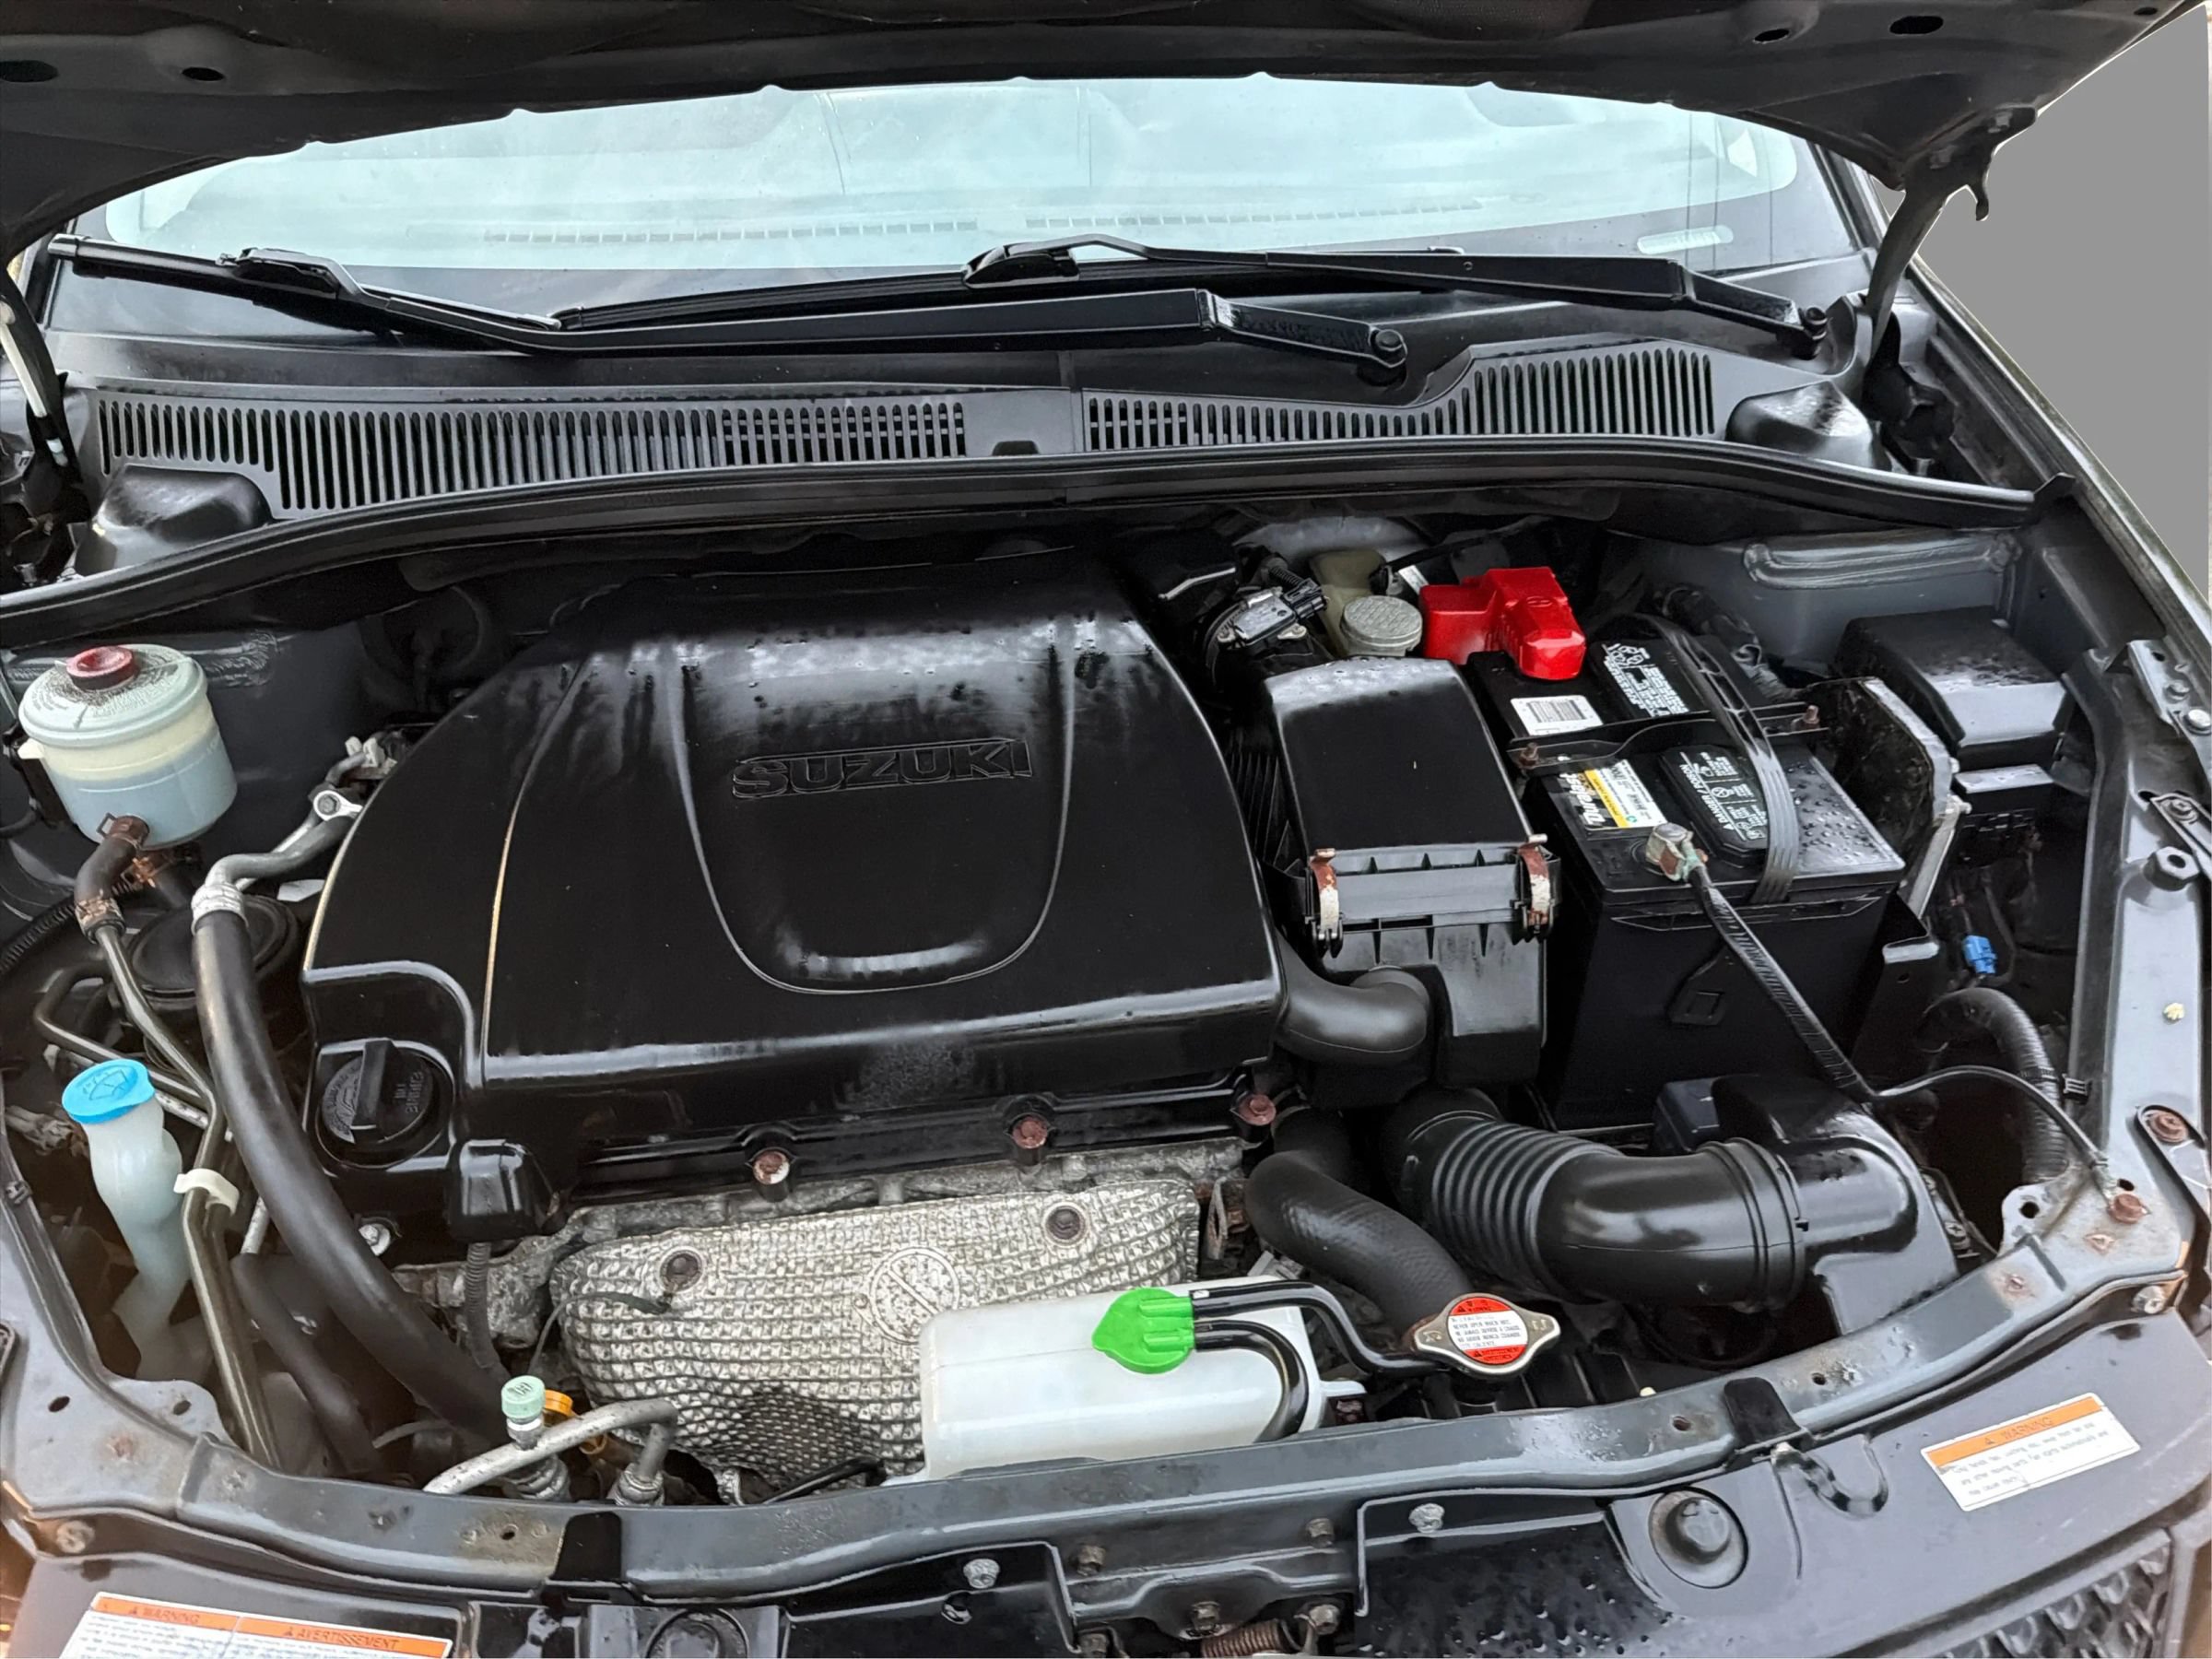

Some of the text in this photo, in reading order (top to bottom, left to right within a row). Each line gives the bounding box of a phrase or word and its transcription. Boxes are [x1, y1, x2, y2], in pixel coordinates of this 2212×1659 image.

[733, 737, 1032, 798] SUZUKI
[1679, 764, 1705, 789] POISON
[1558, 773, 1606, 826] Duralast
[1701, 794, 1730, 824] DANGER
[2000, 1417, 2053, 1441] WARNING
[141, 1606, 201, 1625] WARNING
[296, 1628, 400, 1651] AVERTISSEMENT
